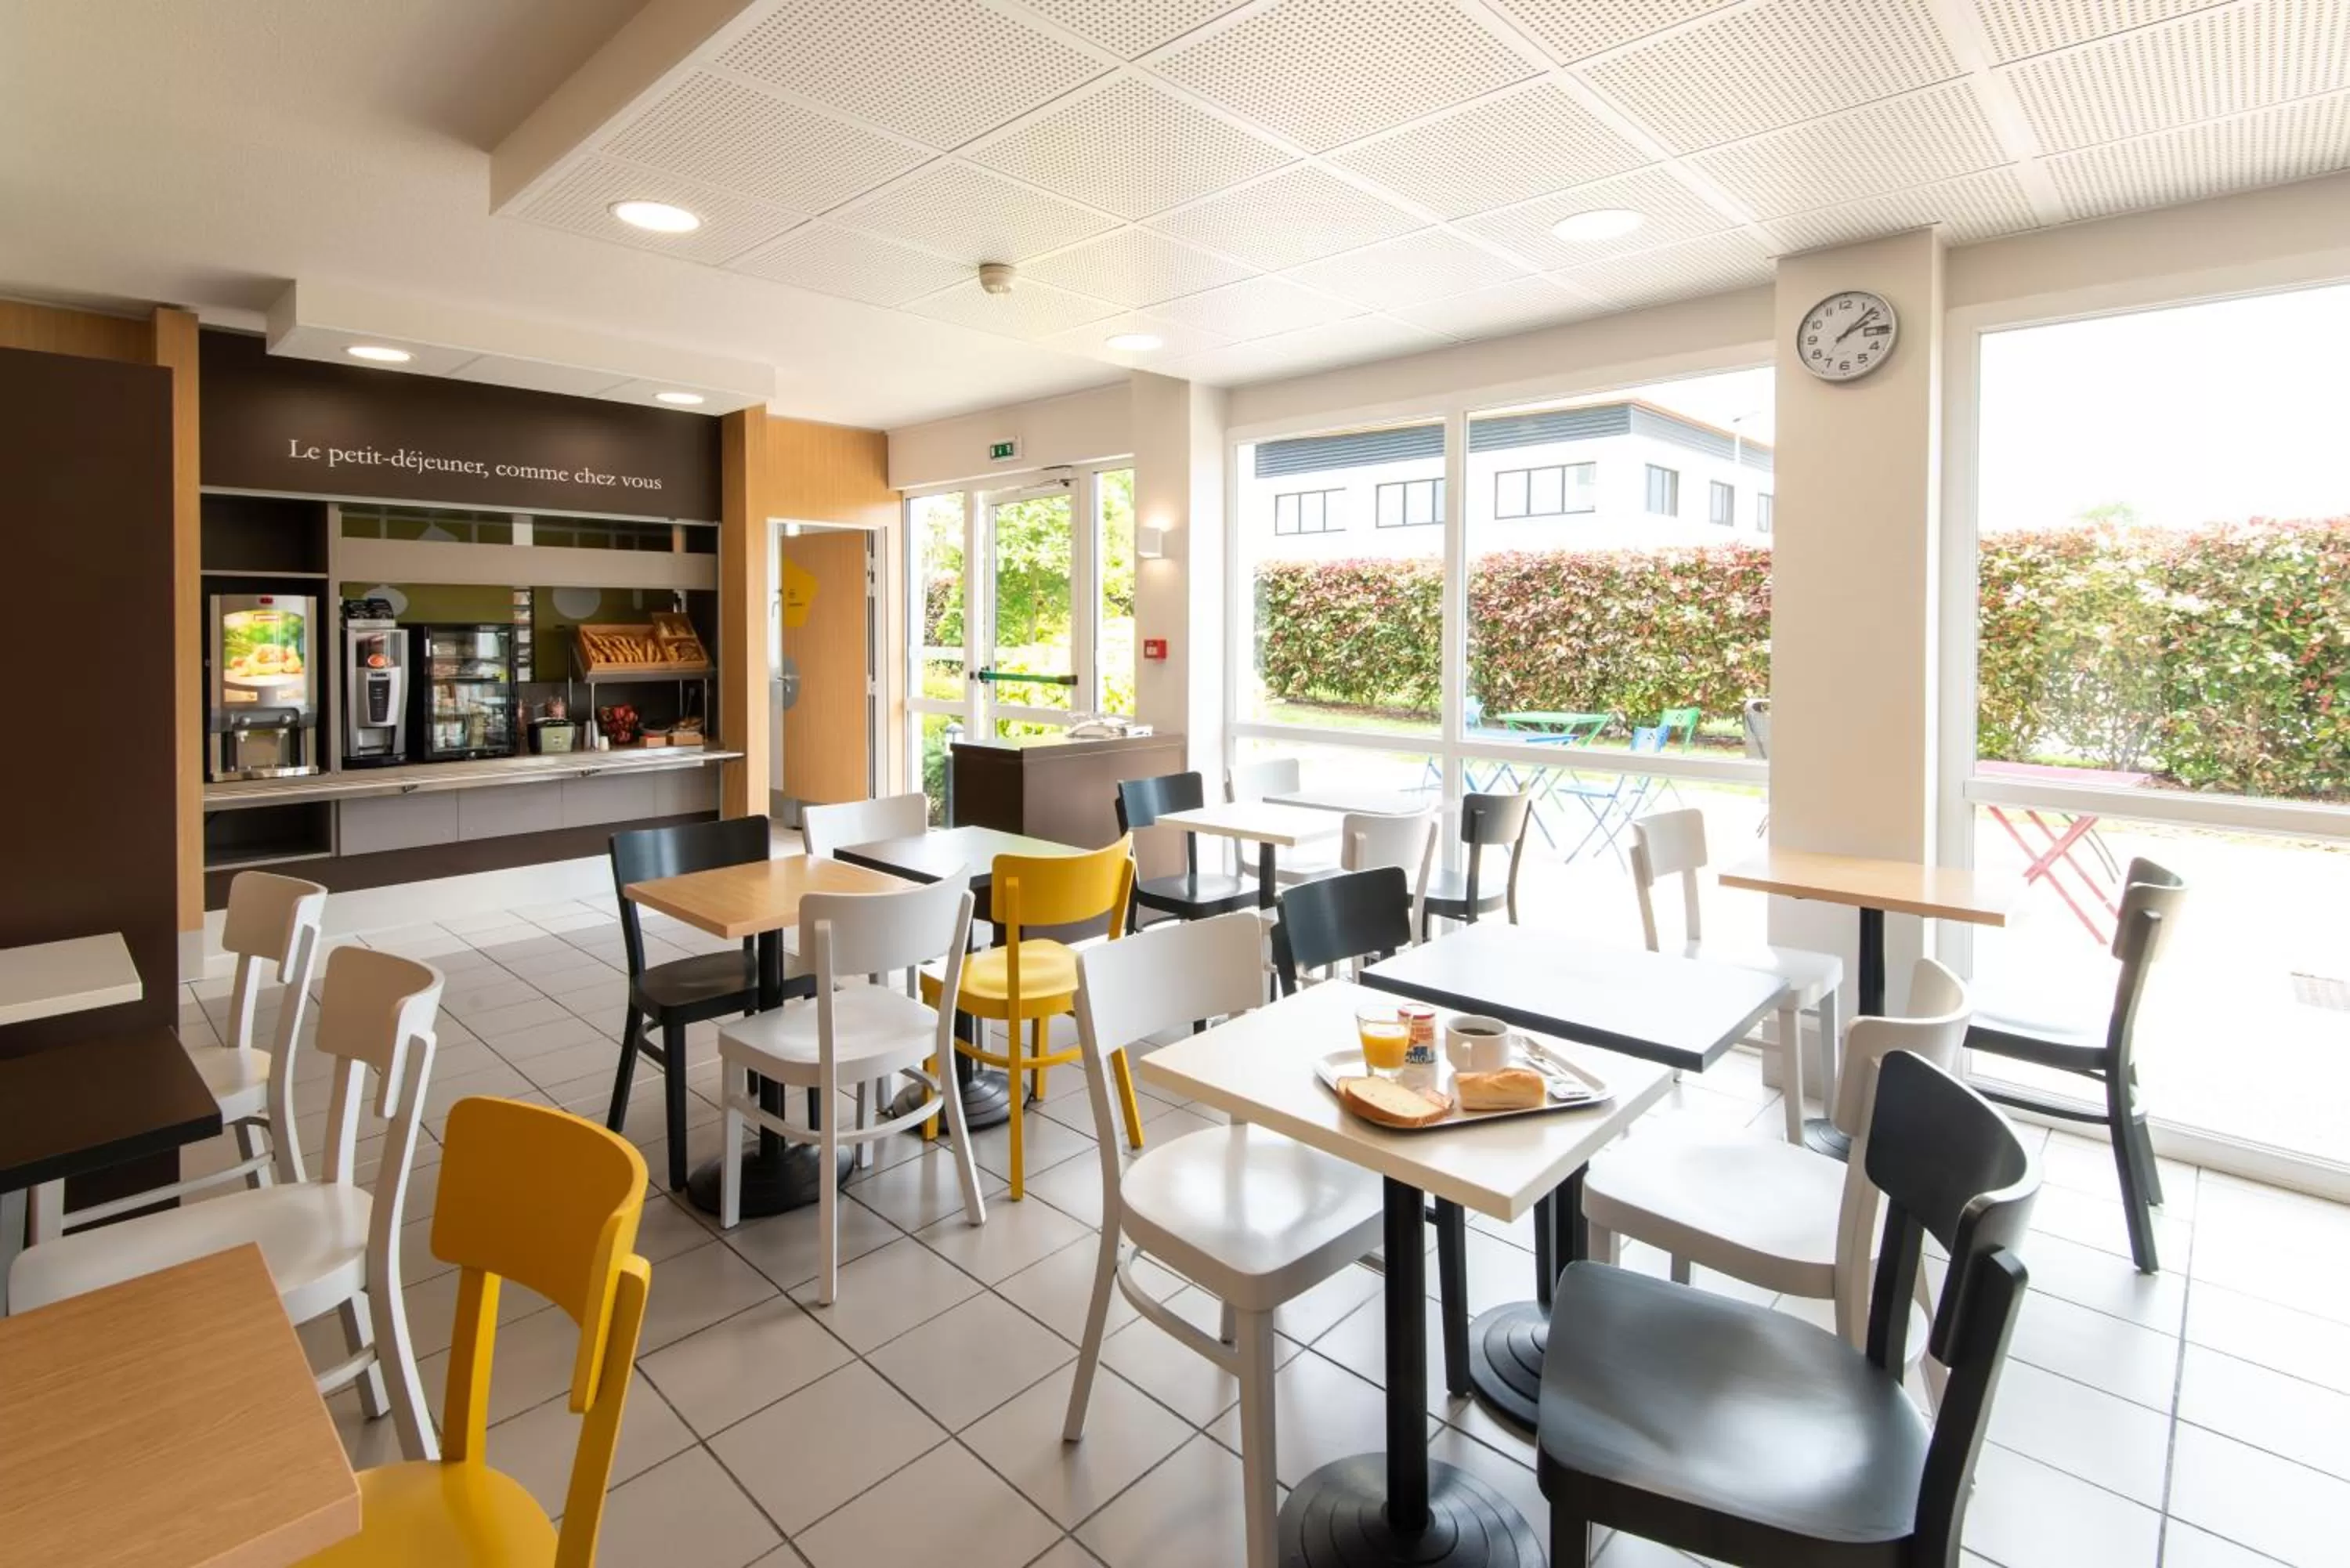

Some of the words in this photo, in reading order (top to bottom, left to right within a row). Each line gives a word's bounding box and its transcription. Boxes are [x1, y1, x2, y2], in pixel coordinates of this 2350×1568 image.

[1839, 300, 1853, 310] 12
[1861, 302, 1866, 311] 1
[1827, 308, 1832, 316] 11
[1812, 320, 1823, 330] 10
[1808, 335, 1818, 345] 9
[1869, 341, 1880, 351] 4
[1812, 349, 1822, 359] 8
[1857, 353, 1868, 363] 5
[1824, 358, 1832, 368] 7
[1839, 362, 1850, 370] 6
[288, 439, 321, 460] Le
[327, 446, 490, 479] petit-déjeuner,
[495, 463, 569, 482] comme
[574, 468, 616, 486] chez
[621, 475, 663, 490] vous
